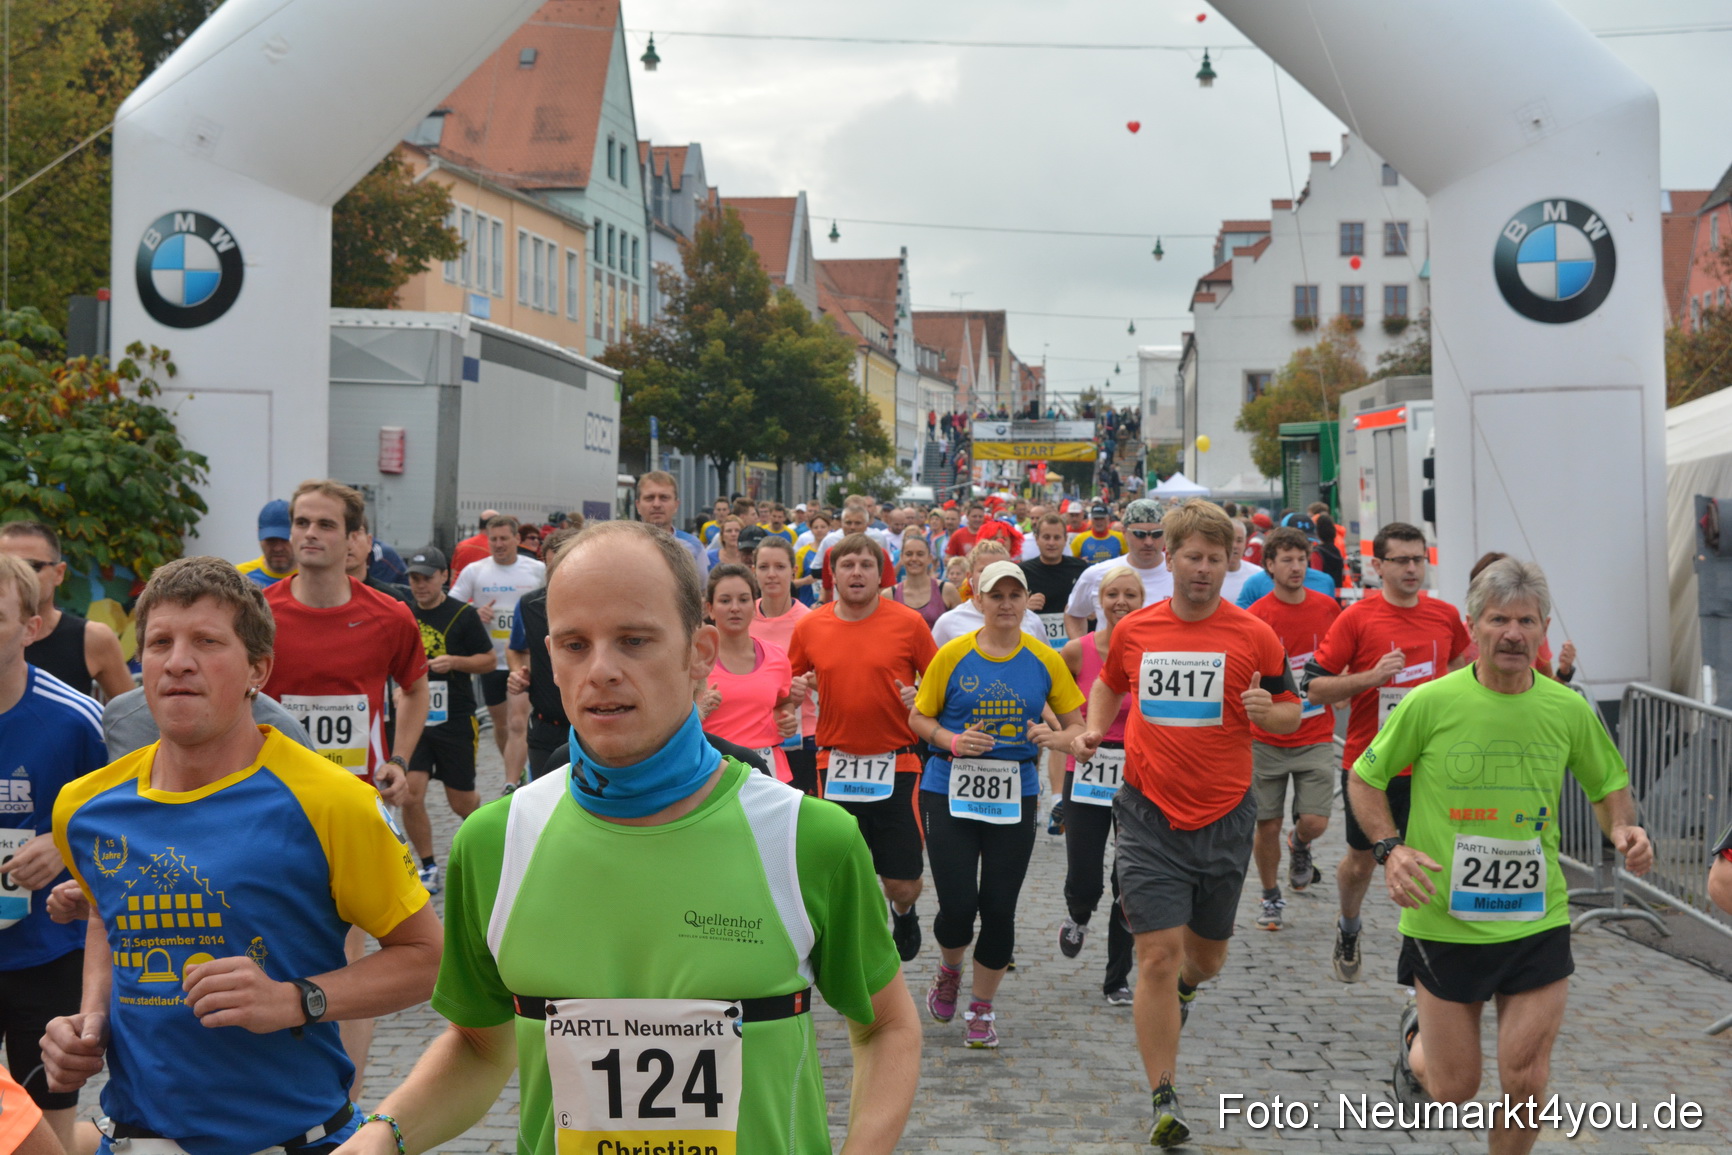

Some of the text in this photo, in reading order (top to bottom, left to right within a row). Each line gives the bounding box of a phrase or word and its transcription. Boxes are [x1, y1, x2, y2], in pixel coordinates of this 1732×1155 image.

[1503, 201, 1608, 243] BMW
[143, 213, 236, 253] BMW
[1013, 446, 1056, 456] START
[1171, 659, 1210, 667] Neumarkt
[1148, 669, 1216, 697] 3417
[312, 703, 354, 712] Neumarkt
[300, 715, 352, 745] 109
[835, 759, 889, 781] 2117
[953, 764, 1009, 774] PARTL Neumarkt
[1081, 761, 1124, 784] 211
[844, 784, 875, 794] Markus
[957, 774, 1012, 799] 2881
[0, 803, 28, 811] OGY
[967, 803, 1002, 815] Sabrina
[1450, 808, 1498, 820] MERZ
[105, 840, 115, 848] 15
[1457, 842, 1536, 856] PARTL Neumarkt
[101, 852, 121, 861] Jahre
[1462, 857, 1540, 889] 2423
[1474, 897, 1522, 910] Michael
[684, 910, 763, 929] Quellenhof
[702, 925, 754, 938] Leutasch
[199, 935, 225, 945] 2014
[550, 1019, 724, 1036] PARTL Neumarkt
[591, 1048, 724, 1119] 124
[597, 1139, 719, 1155] Christian
